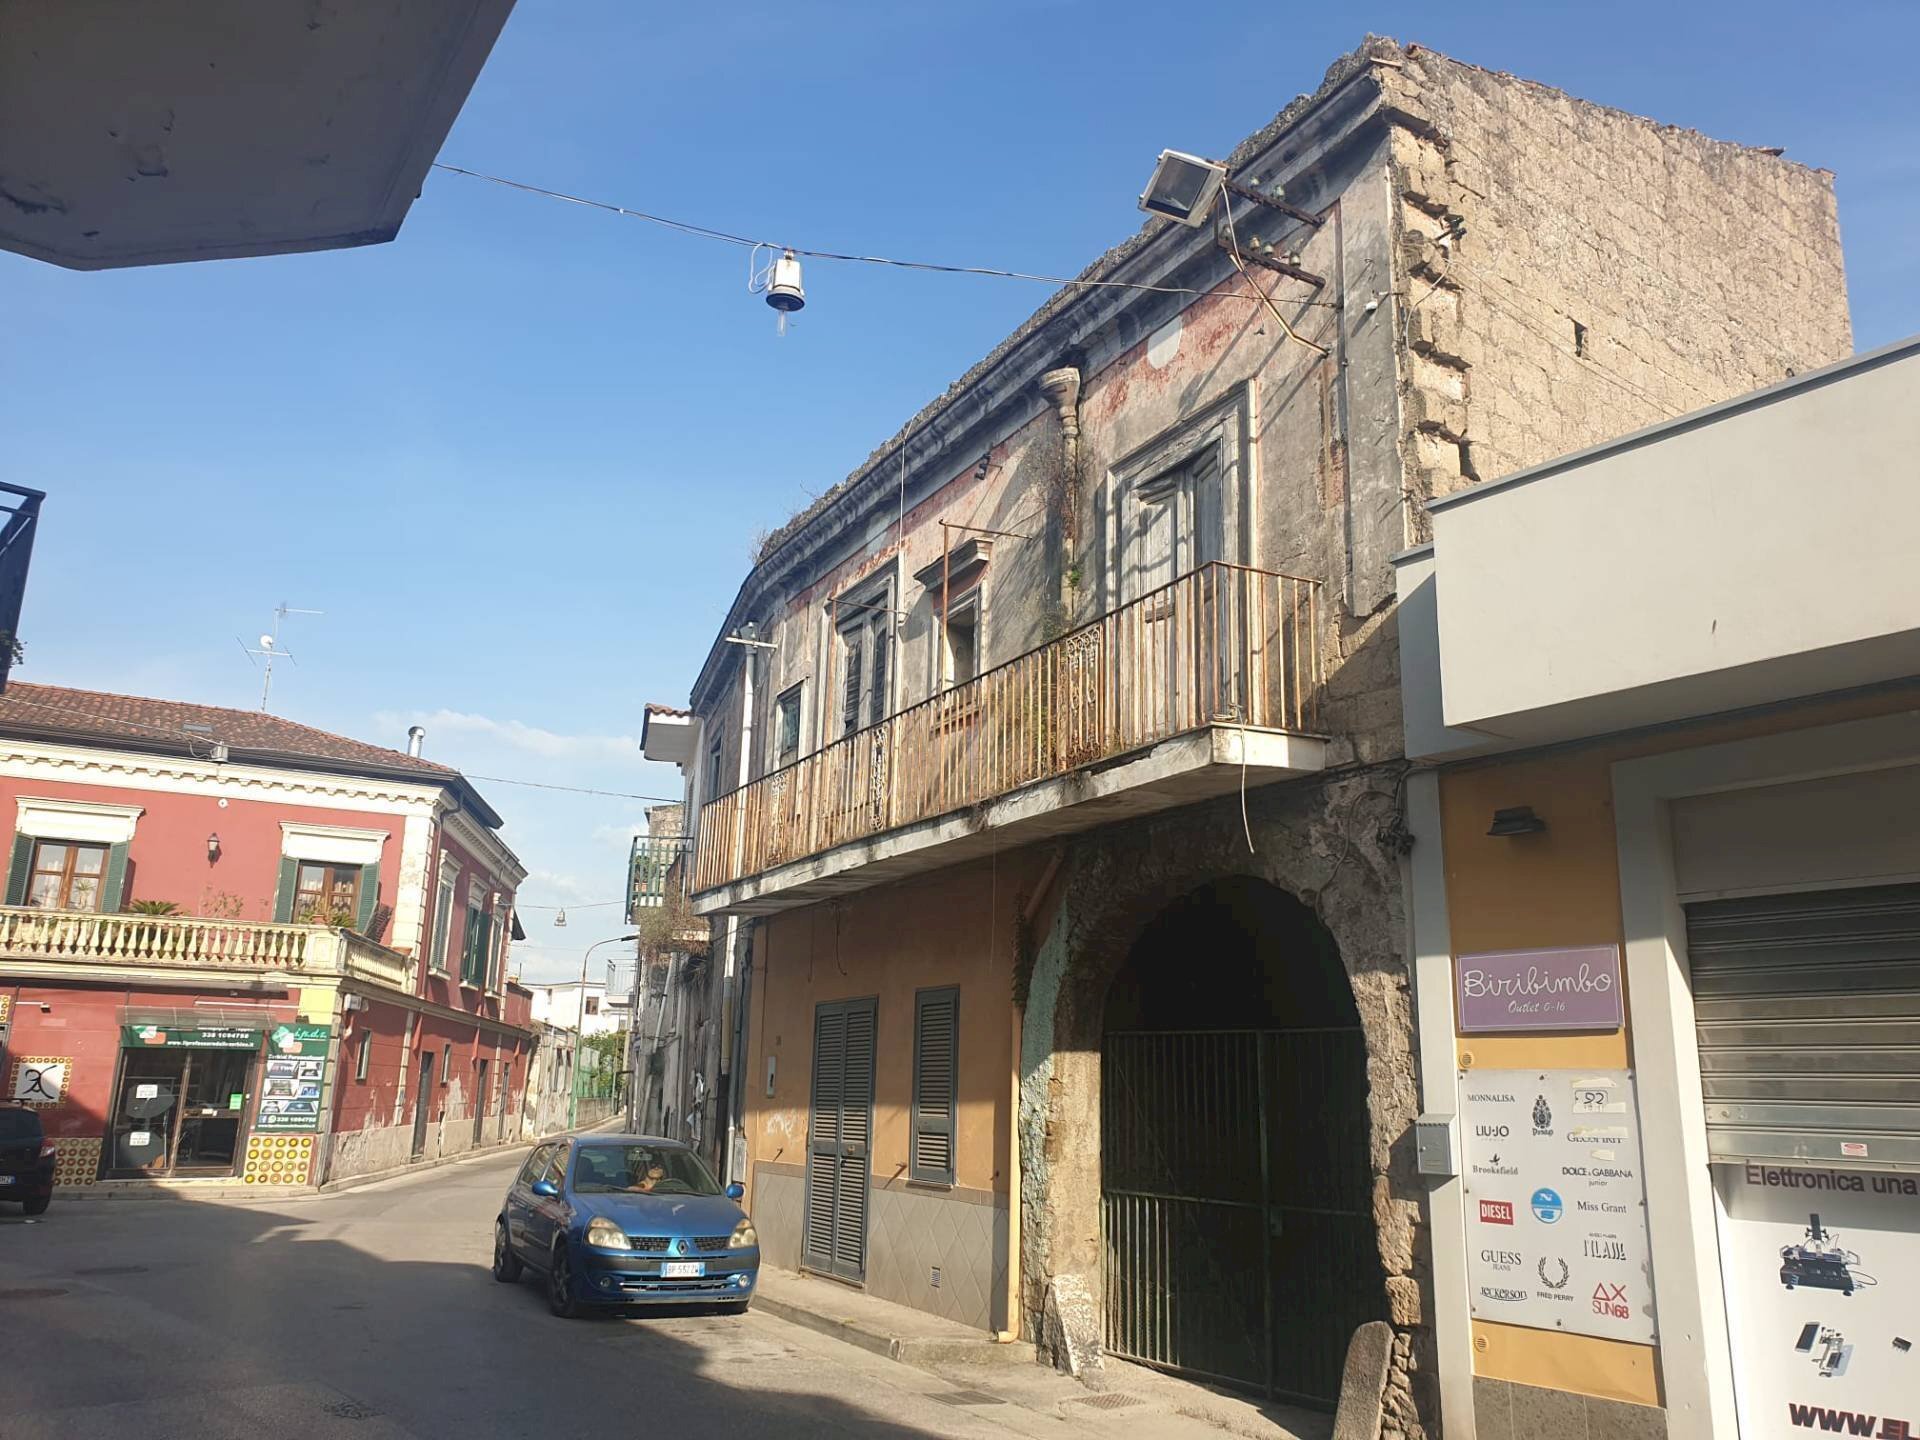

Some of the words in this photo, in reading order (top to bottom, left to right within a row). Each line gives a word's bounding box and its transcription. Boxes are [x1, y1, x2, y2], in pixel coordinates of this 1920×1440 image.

[1464, 963, 1612, 997] Biribimbo
[1508, 1001, 1540, 1013] Outlet
[1467, 1094, 1515, 1102] MONNALISA
[1472, 1165, 1519, 1175] Brooksfield
[1562, 1167, 1586, 1176] DOLCE
[1592, 1168, 1633, 1178] GABBANA
[1745, 1164, 1865, 1192] Elettronica
[1872, 1175, 1918, 1196] una
[1481, 1204, 1512, 1220] DIESEL
[1577, 1201, 1599, 1211] Miss
[1601, 1202, 1627, 1213] Grant
[1481, 1249, 1522, 1266] GUESS
[1536, 1291, 1553, 1299] FRED
[1554, 1293, 1574, 1301] PERRY
[1592, 1300, 1629, 1319] SUN68
